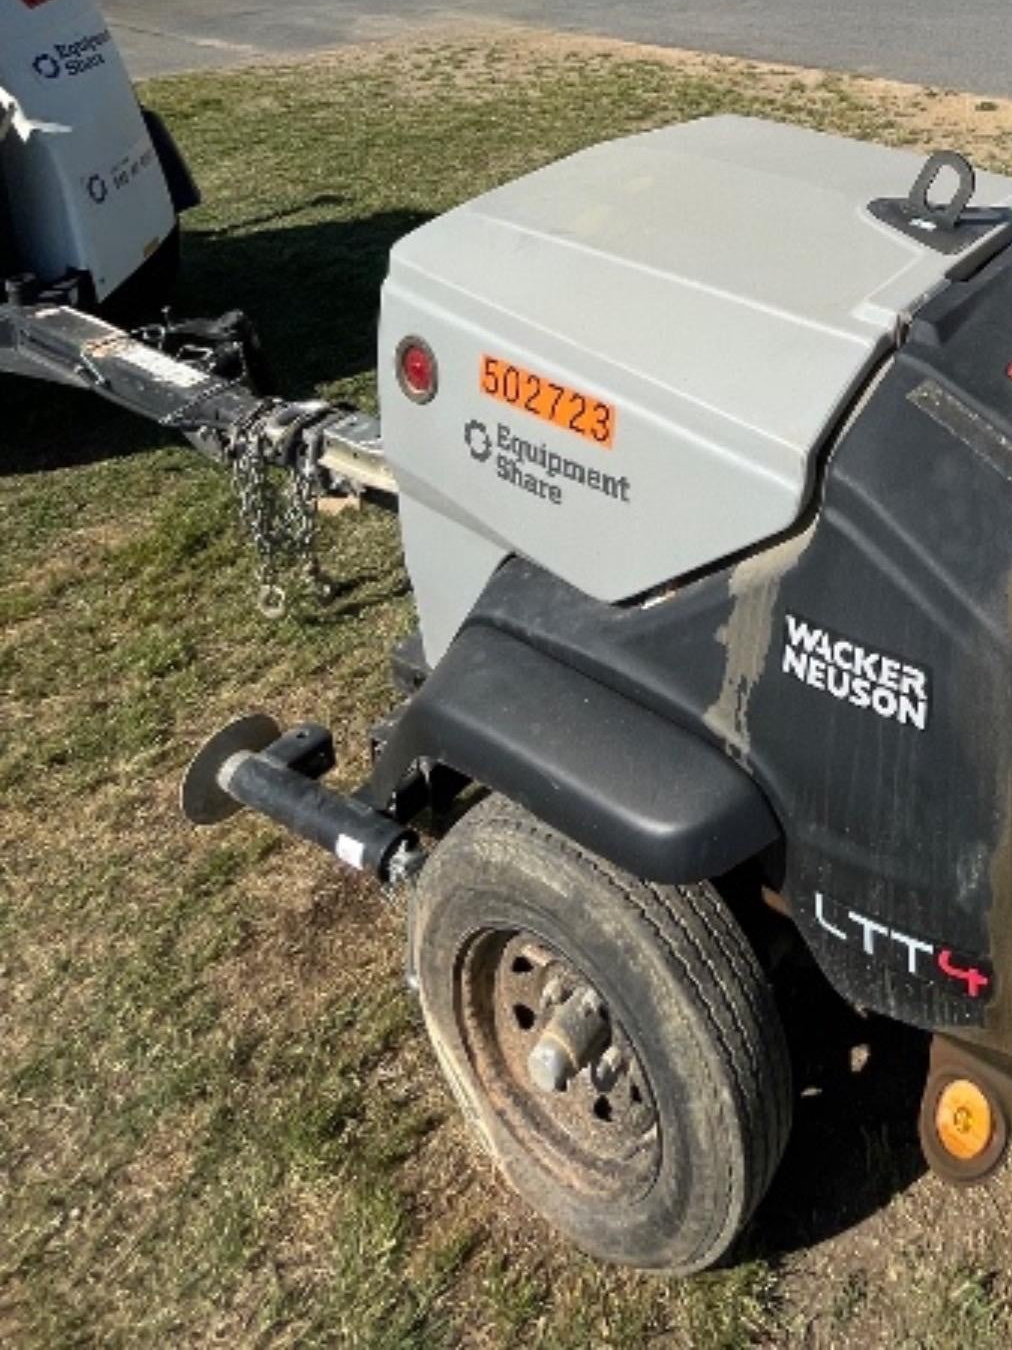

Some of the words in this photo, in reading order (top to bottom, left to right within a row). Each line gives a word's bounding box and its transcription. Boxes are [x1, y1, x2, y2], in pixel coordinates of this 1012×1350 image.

[483, 356, 611, 443] 502723
[496, 422, 631, 502] Equipment
[496, 453, 562, 505] Share
[781, 644, 928, 731] NEUSON
[785, 613, 928, 701] WACKER
